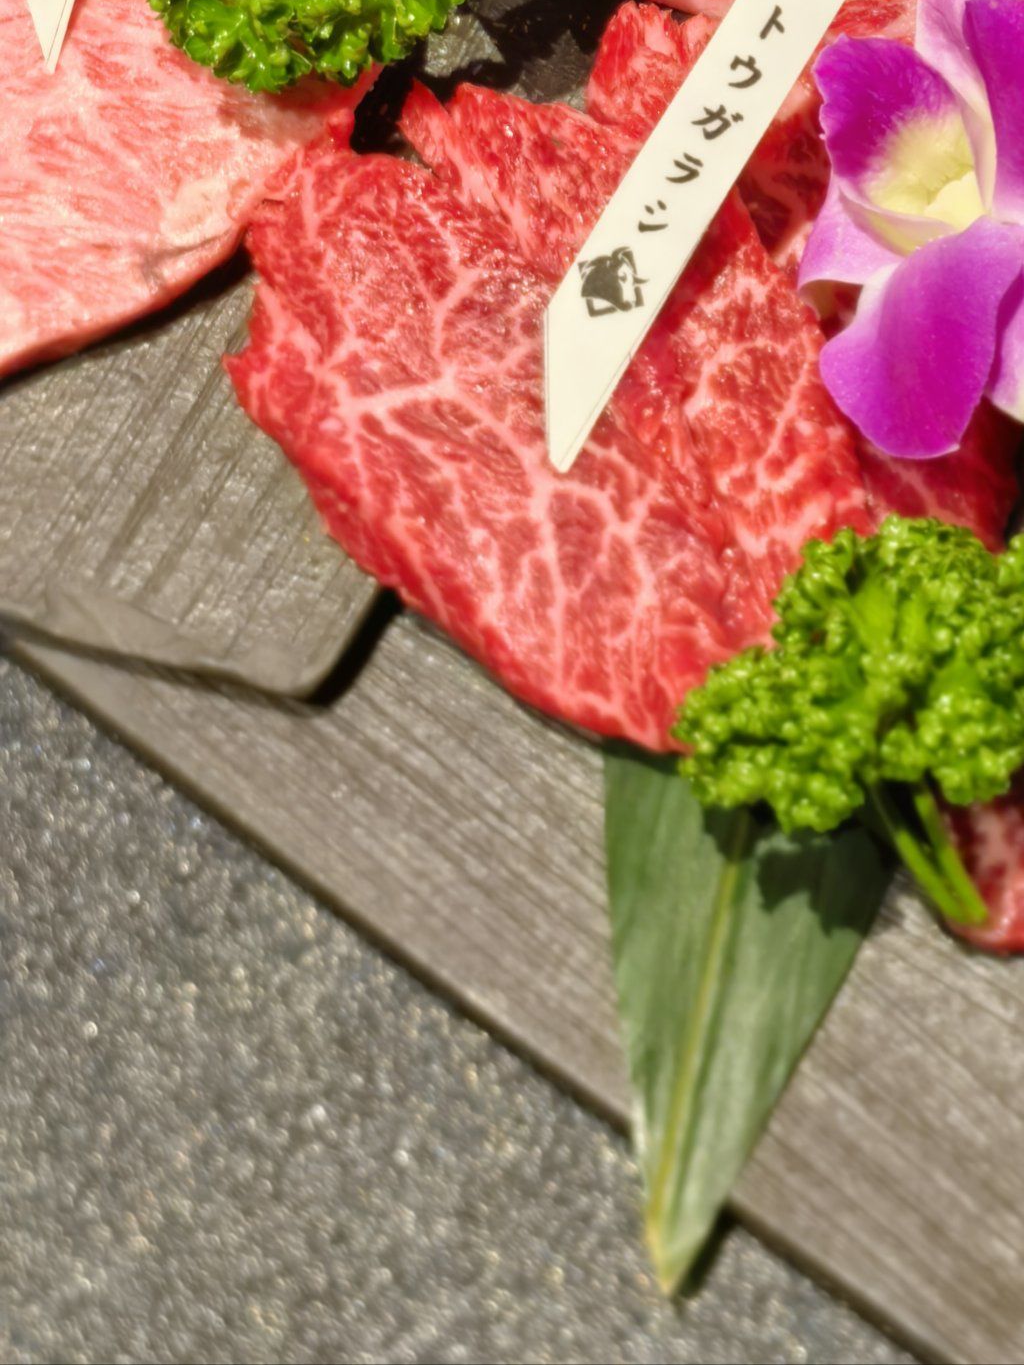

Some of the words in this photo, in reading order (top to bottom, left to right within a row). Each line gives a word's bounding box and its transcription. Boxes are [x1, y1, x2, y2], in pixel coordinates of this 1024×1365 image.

[638, 4, 786, 234] トウガラシ
